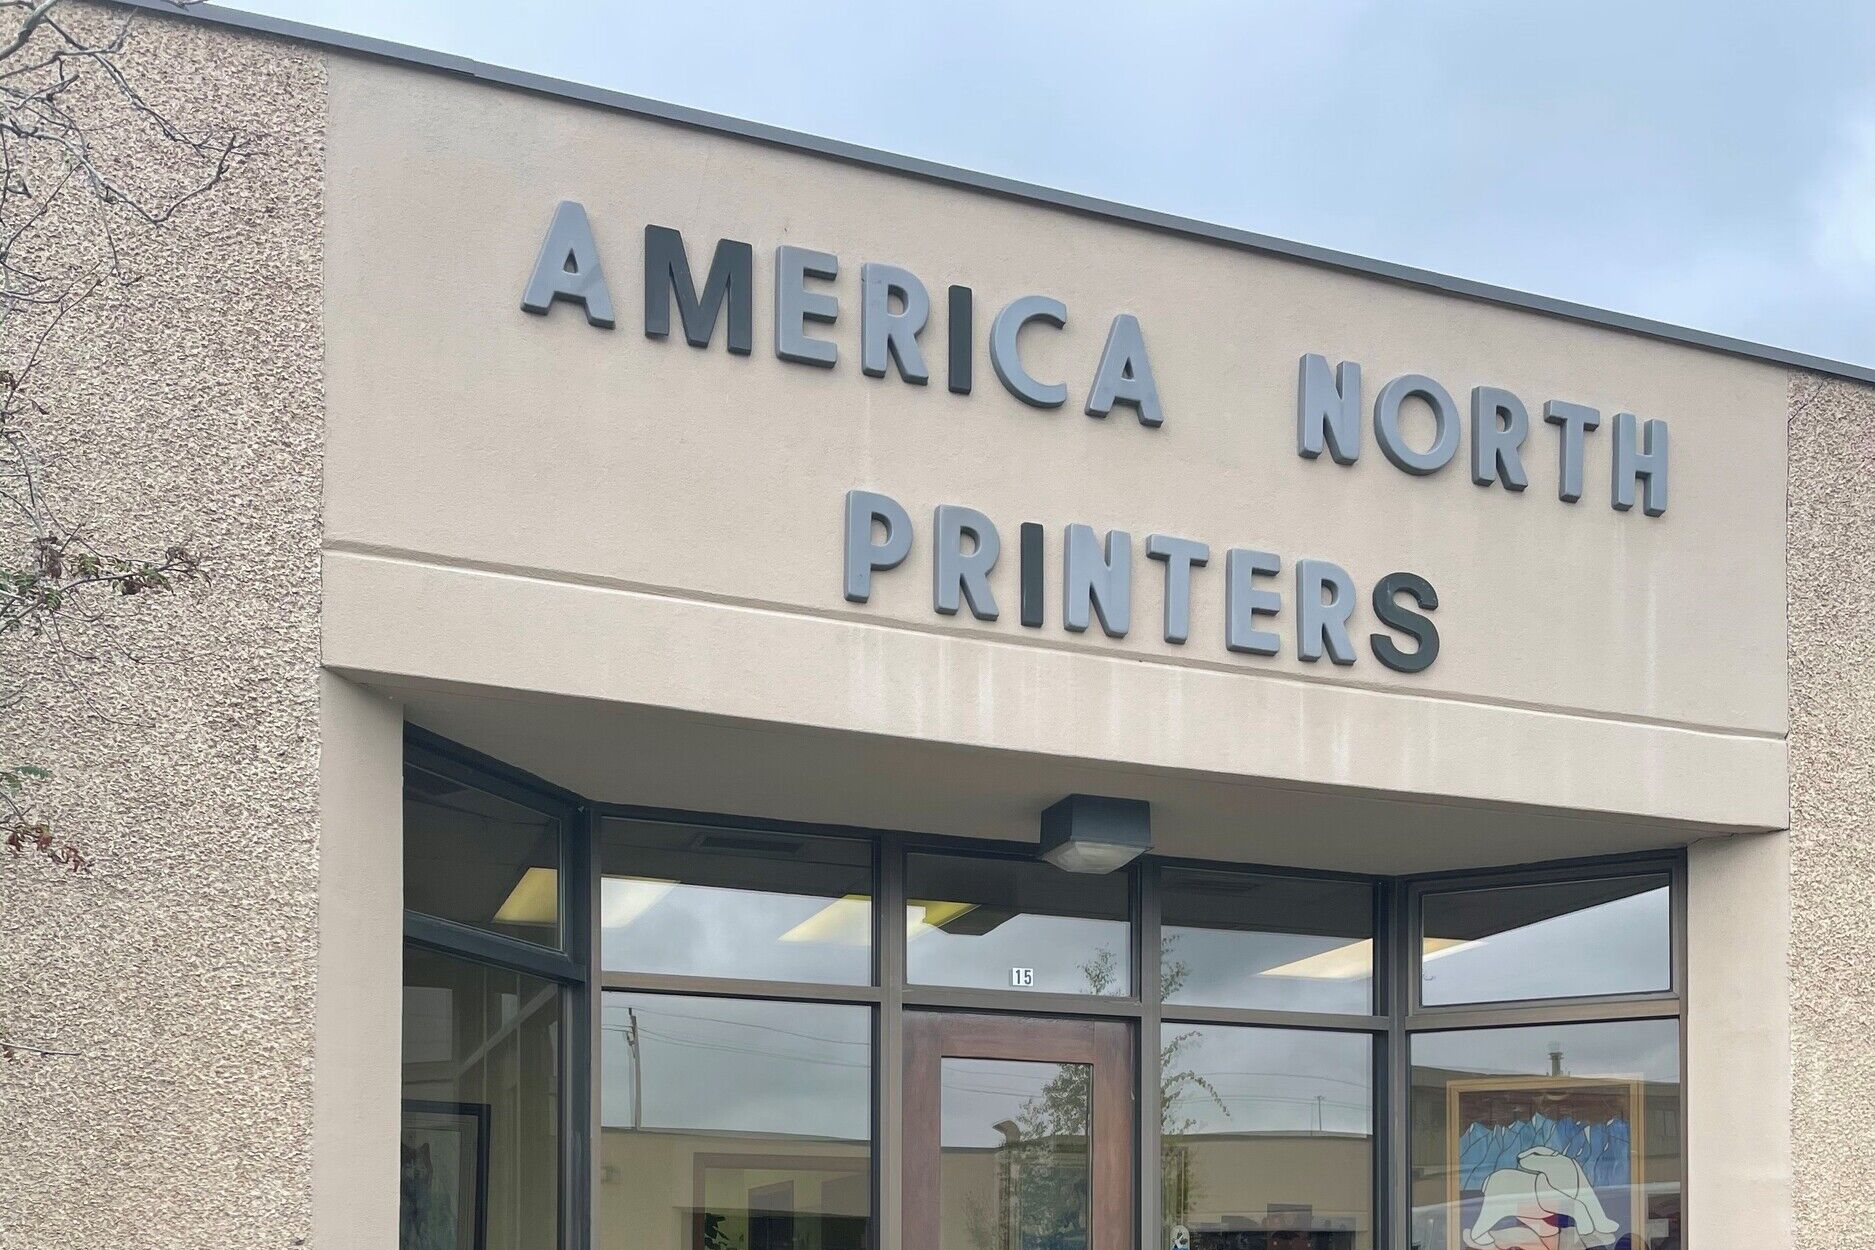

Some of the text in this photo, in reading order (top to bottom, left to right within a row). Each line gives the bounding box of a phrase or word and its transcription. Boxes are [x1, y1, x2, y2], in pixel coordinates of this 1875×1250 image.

[519, 200, 1669, 518] AMERICA NORTH
[843, 489, 1441, 673] PRINTERS
[1015, 969, 1032, 985] 15
